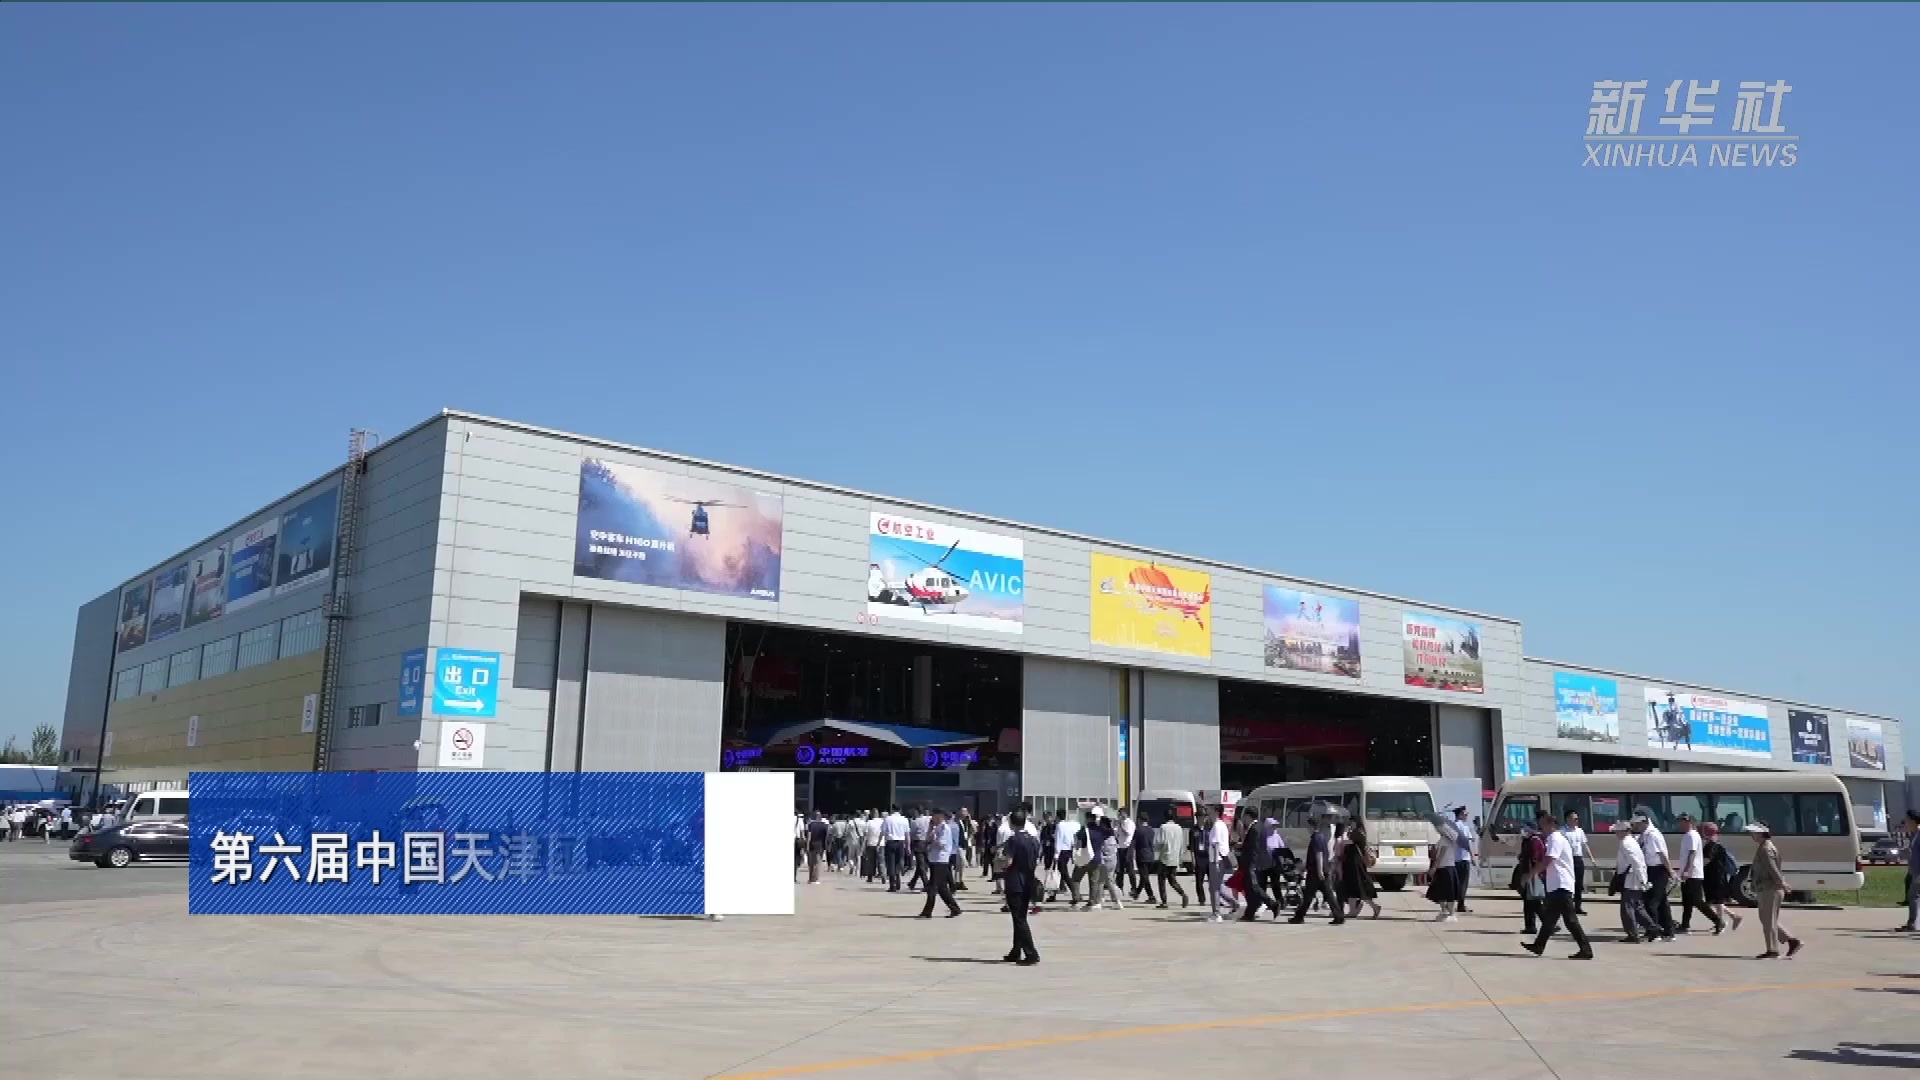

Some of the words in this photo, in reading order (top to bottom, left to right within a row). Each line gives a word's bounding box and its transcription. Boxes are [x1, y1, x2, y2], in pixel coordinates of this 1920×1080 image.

[969, 569, 1022, 595] AVIC
[444, 665, 489, 685] 出口
[455, 685, 476, 697] Exit
